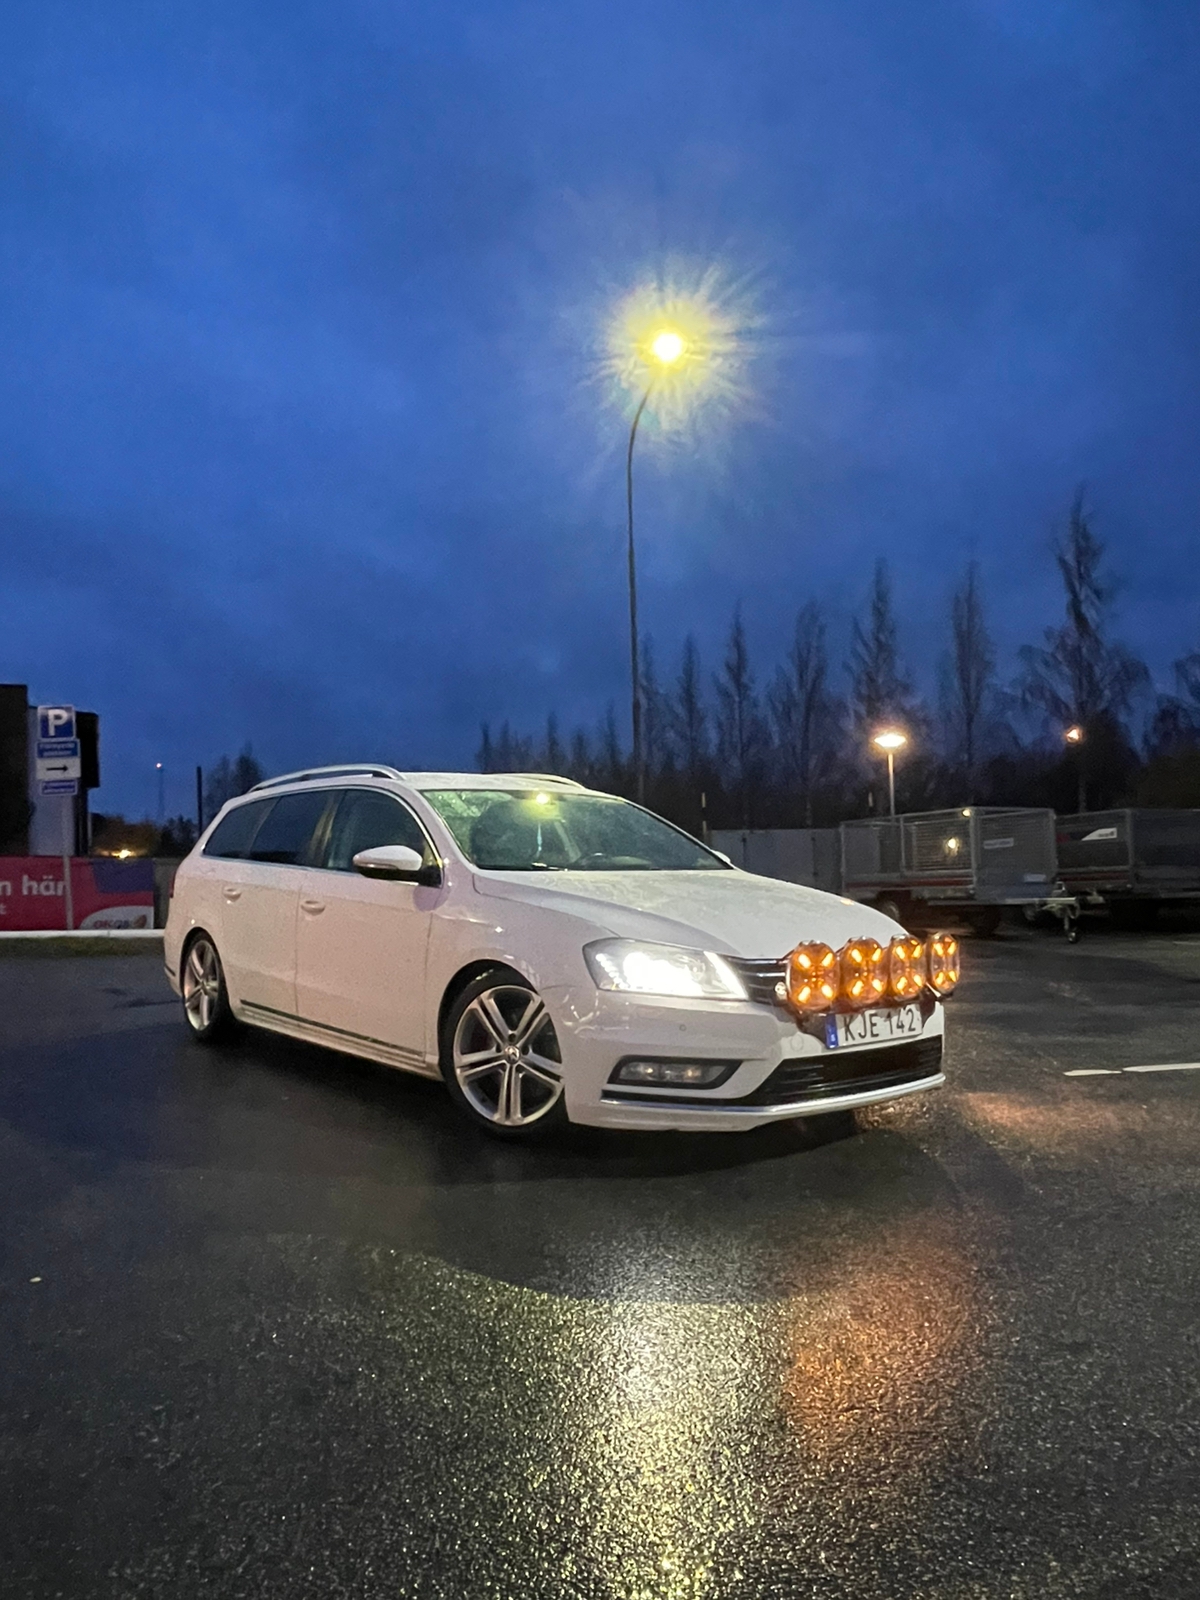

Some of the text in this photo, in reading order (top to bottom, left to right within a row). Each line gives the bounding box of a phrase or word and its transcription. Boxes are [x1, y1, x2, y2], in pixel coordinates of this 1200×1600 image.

[48, 709, 68, 736] P
[22, 874, 66, 896] här
[843, 1007, 916, 1041] KJE 142
